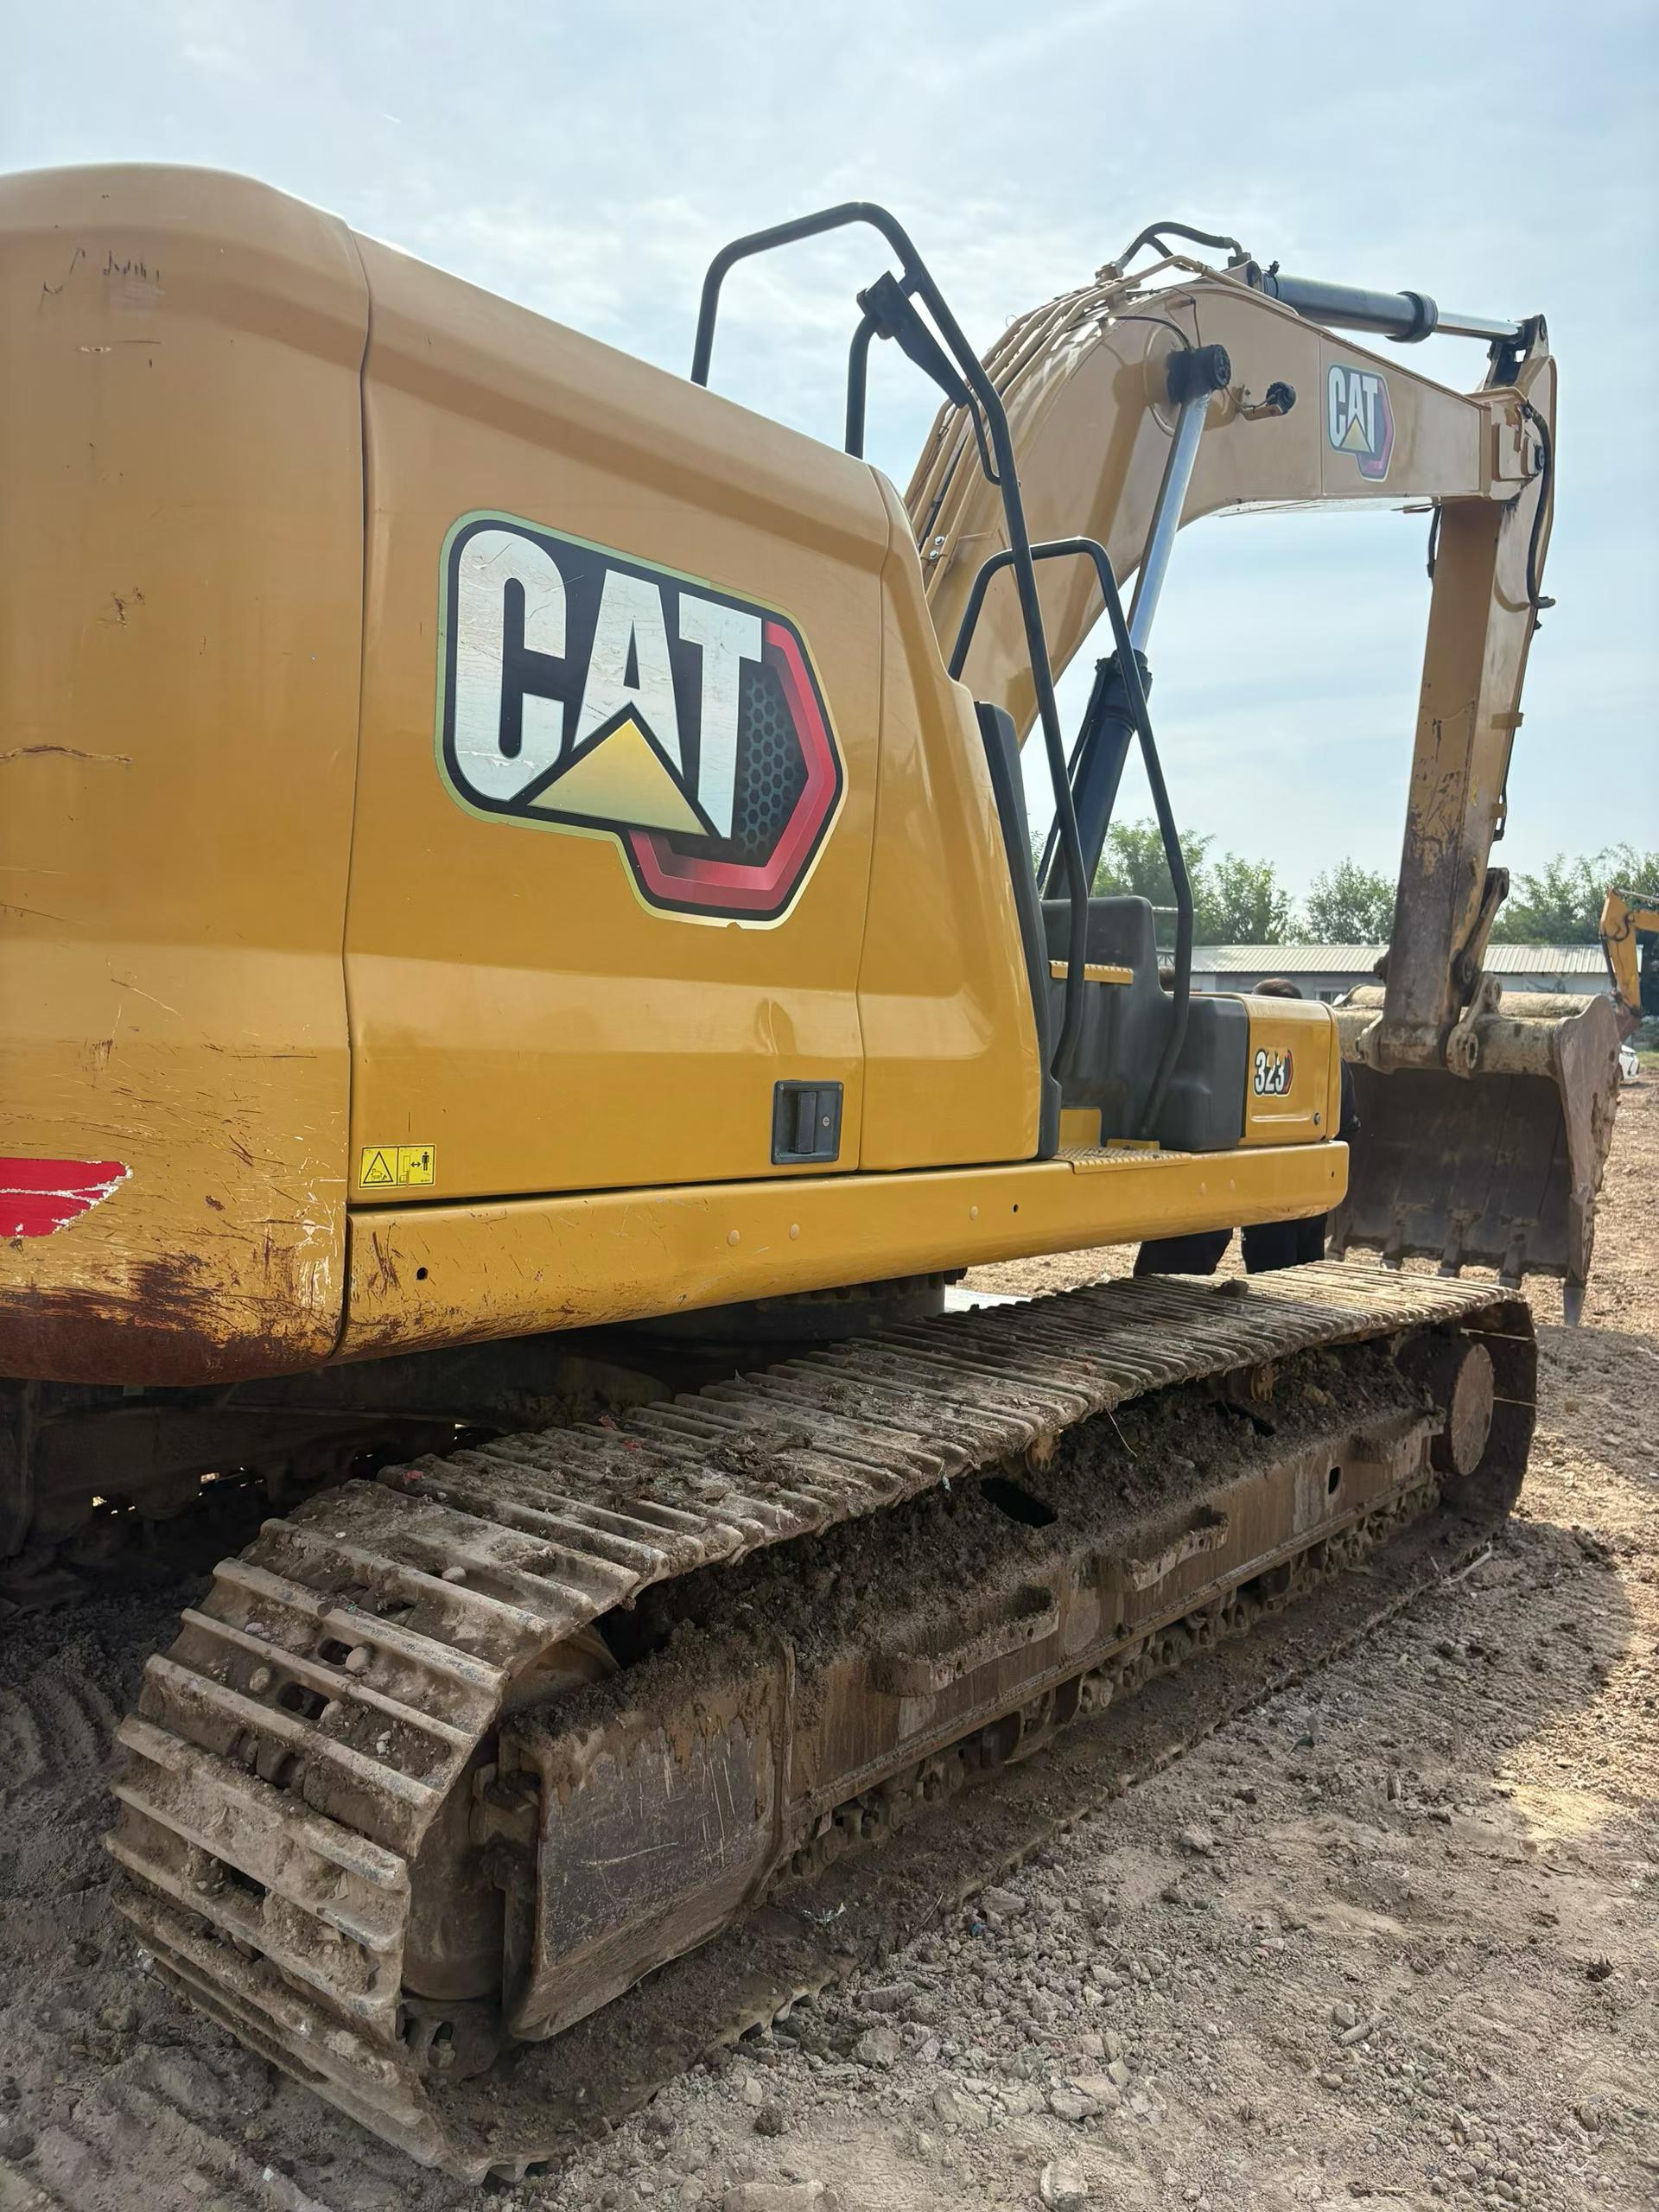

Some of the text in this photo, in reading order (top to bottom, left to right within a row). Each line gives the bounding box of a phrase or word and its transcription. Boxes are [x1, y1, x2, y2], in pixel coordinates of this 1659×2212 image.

[1329, 366, 1378, 453] CAT
[454, 530, 762, 840] CAT
[1255, 1051, 1285, 1092] 323
